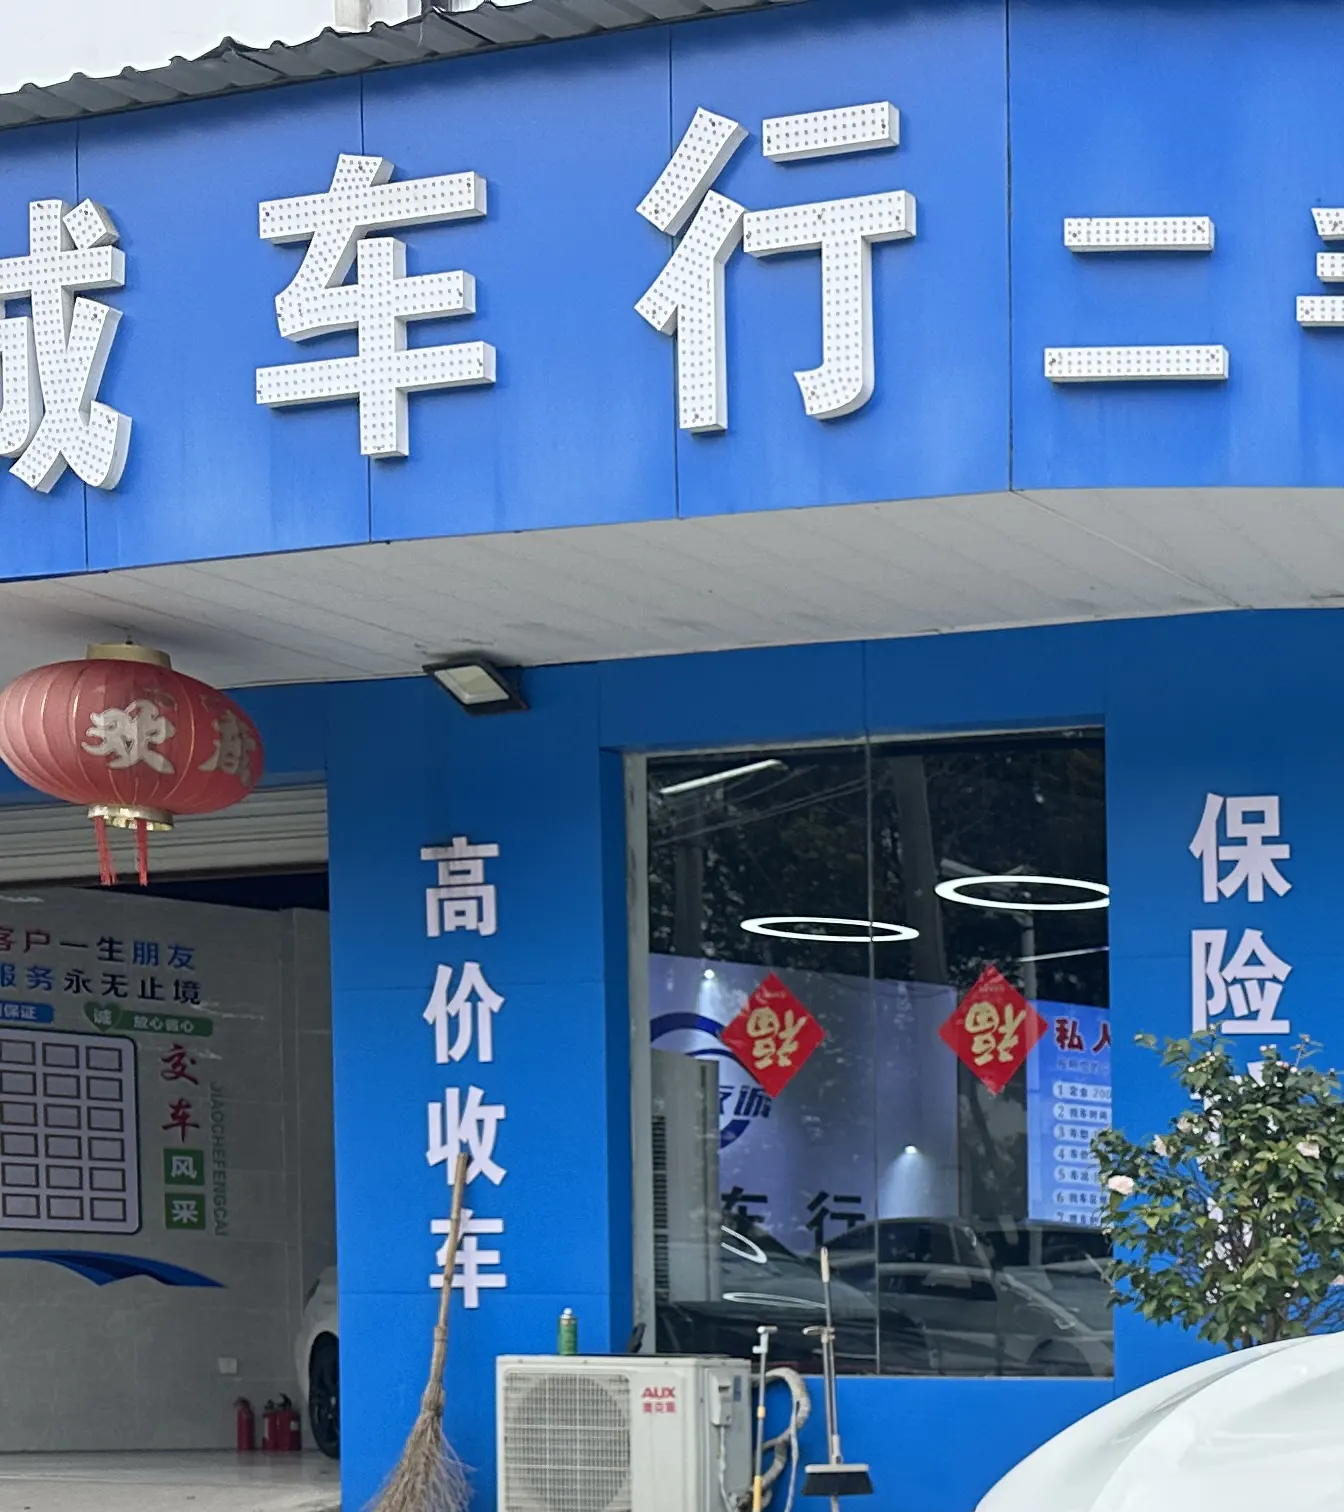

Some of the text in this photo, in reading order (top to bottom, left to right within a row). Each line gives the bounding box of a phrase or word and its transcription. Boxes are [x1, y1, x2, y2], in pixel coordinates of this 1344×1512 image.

[0, 1003, 37, 1020] 保证
[420, 836, 507, 1309] 高价收车
[641, 1386, 676, 1399] AUX
